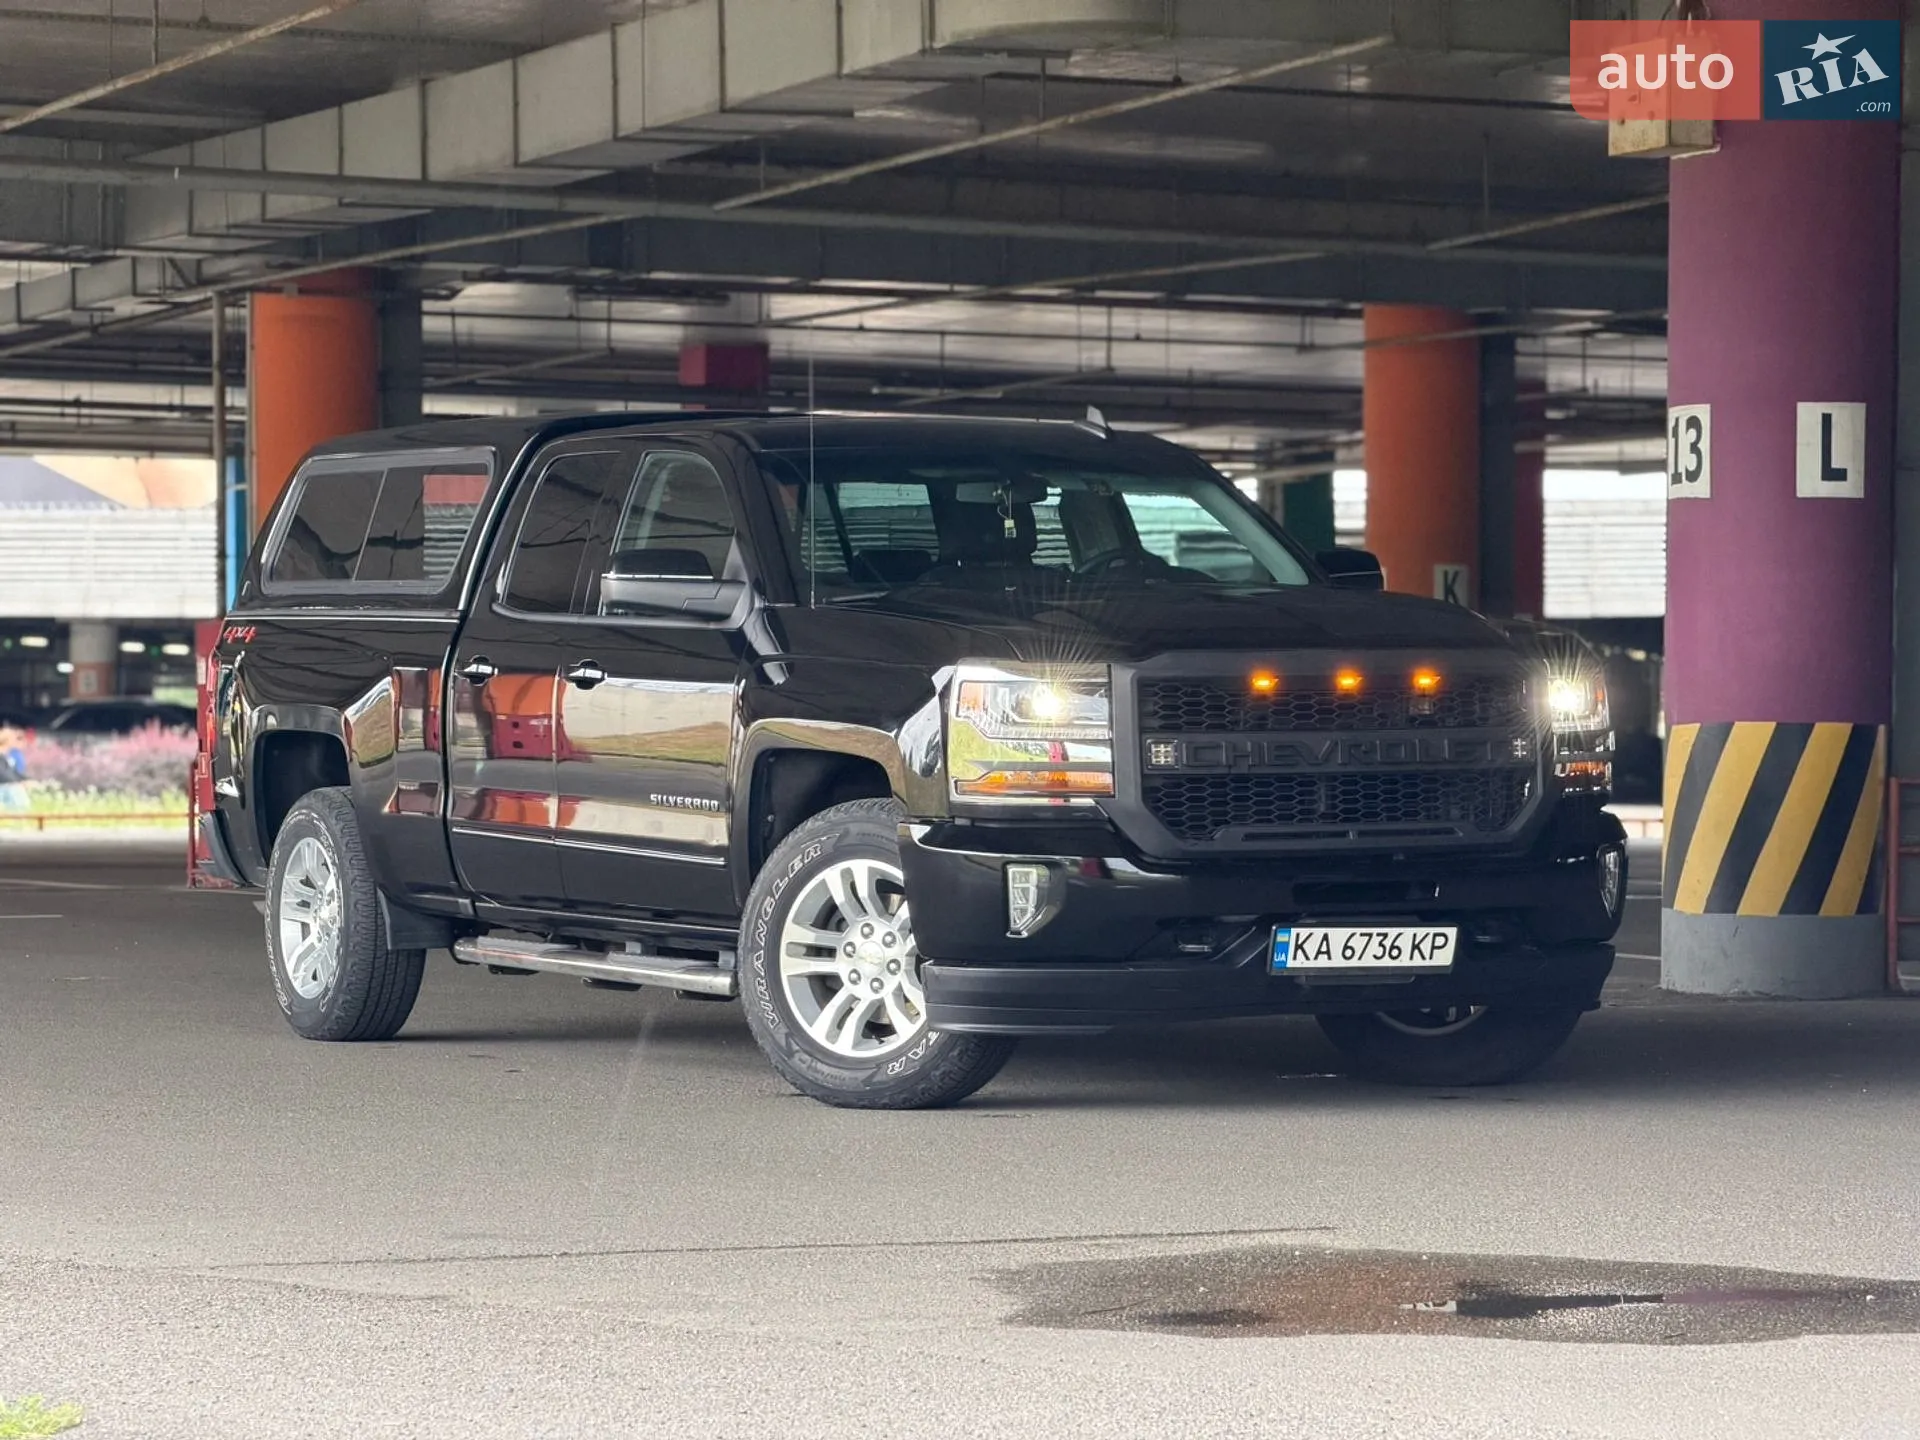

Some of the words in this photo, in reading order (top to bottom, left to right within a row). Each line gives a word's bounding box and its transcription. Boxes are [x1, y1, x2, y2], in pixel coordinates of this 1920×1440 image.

[1671, 415, 1703, 485] 13
[1821, 413, 1848, 482] L
[1443, 569, 1460, 603] K
[1182, 738, 1502, 768] CHEVROLET
[650, 793, 719, 812] SILVERADO
[753, 843, 822, 1029] WRANGLER
[1292, 932, 1332, 961] KA
[1341, 932, 1404, 961] 6736
[1409, 932, 1449, 961] KP
[1273, 951, 1287, 962] UA
